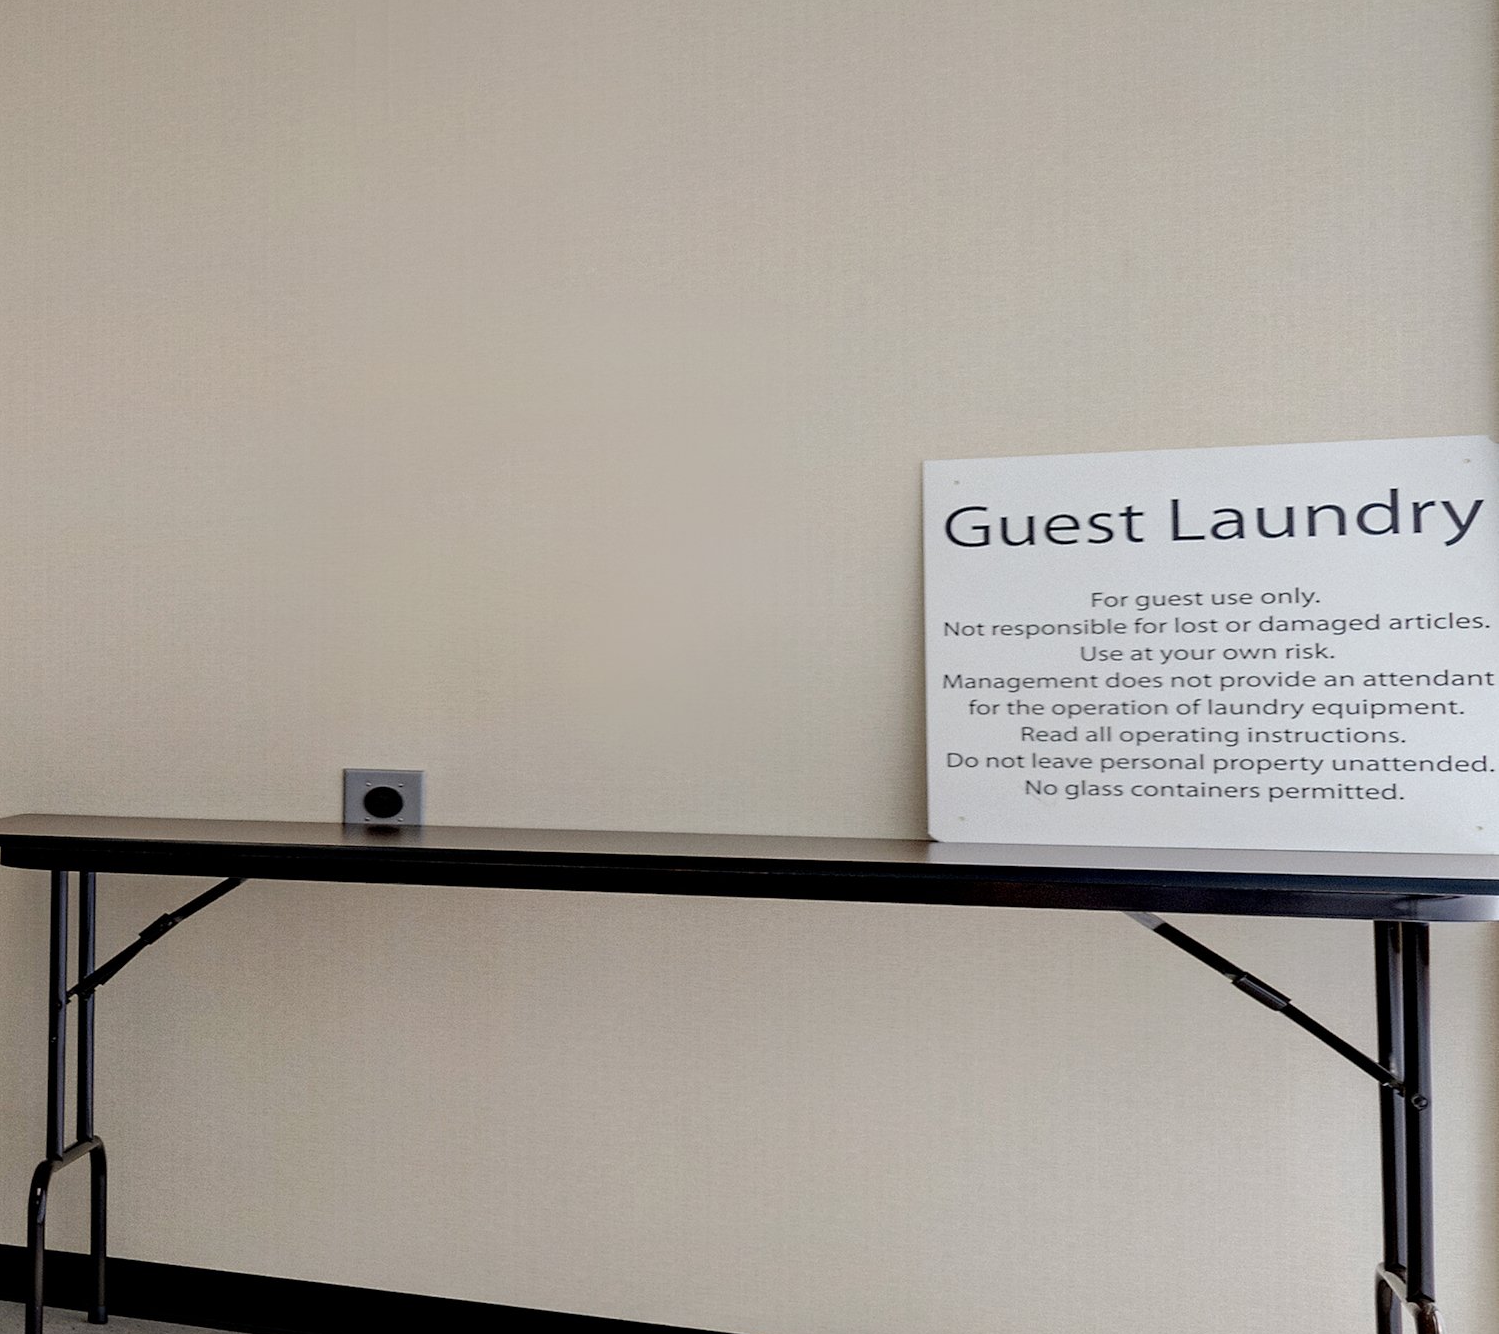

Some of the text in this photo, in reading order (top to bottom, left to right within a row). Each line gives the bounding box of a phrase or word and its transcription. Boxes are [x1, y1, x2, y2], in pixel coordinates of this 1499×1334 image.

[944, 487, 1485, 548] Guest Laundry
[1091, 587, 1321, 612] For guest use only.
[944, 612, 1491, 640] Not responsible for lost or damaged articles.
[1080, 642, 1335, 665] Use at your own risk.
[943, 669, 1495, 693] Management does not provide an attendant
[968, 698, 1465, 720] for the operation of laundry equipment.
[1021, 726, 1406, 748] Read all operating instructions.
[946, 752, 1495, 776] Do not leave personal property unattended.
[1025, 779, 1405, 803] No glass containers permitted.
